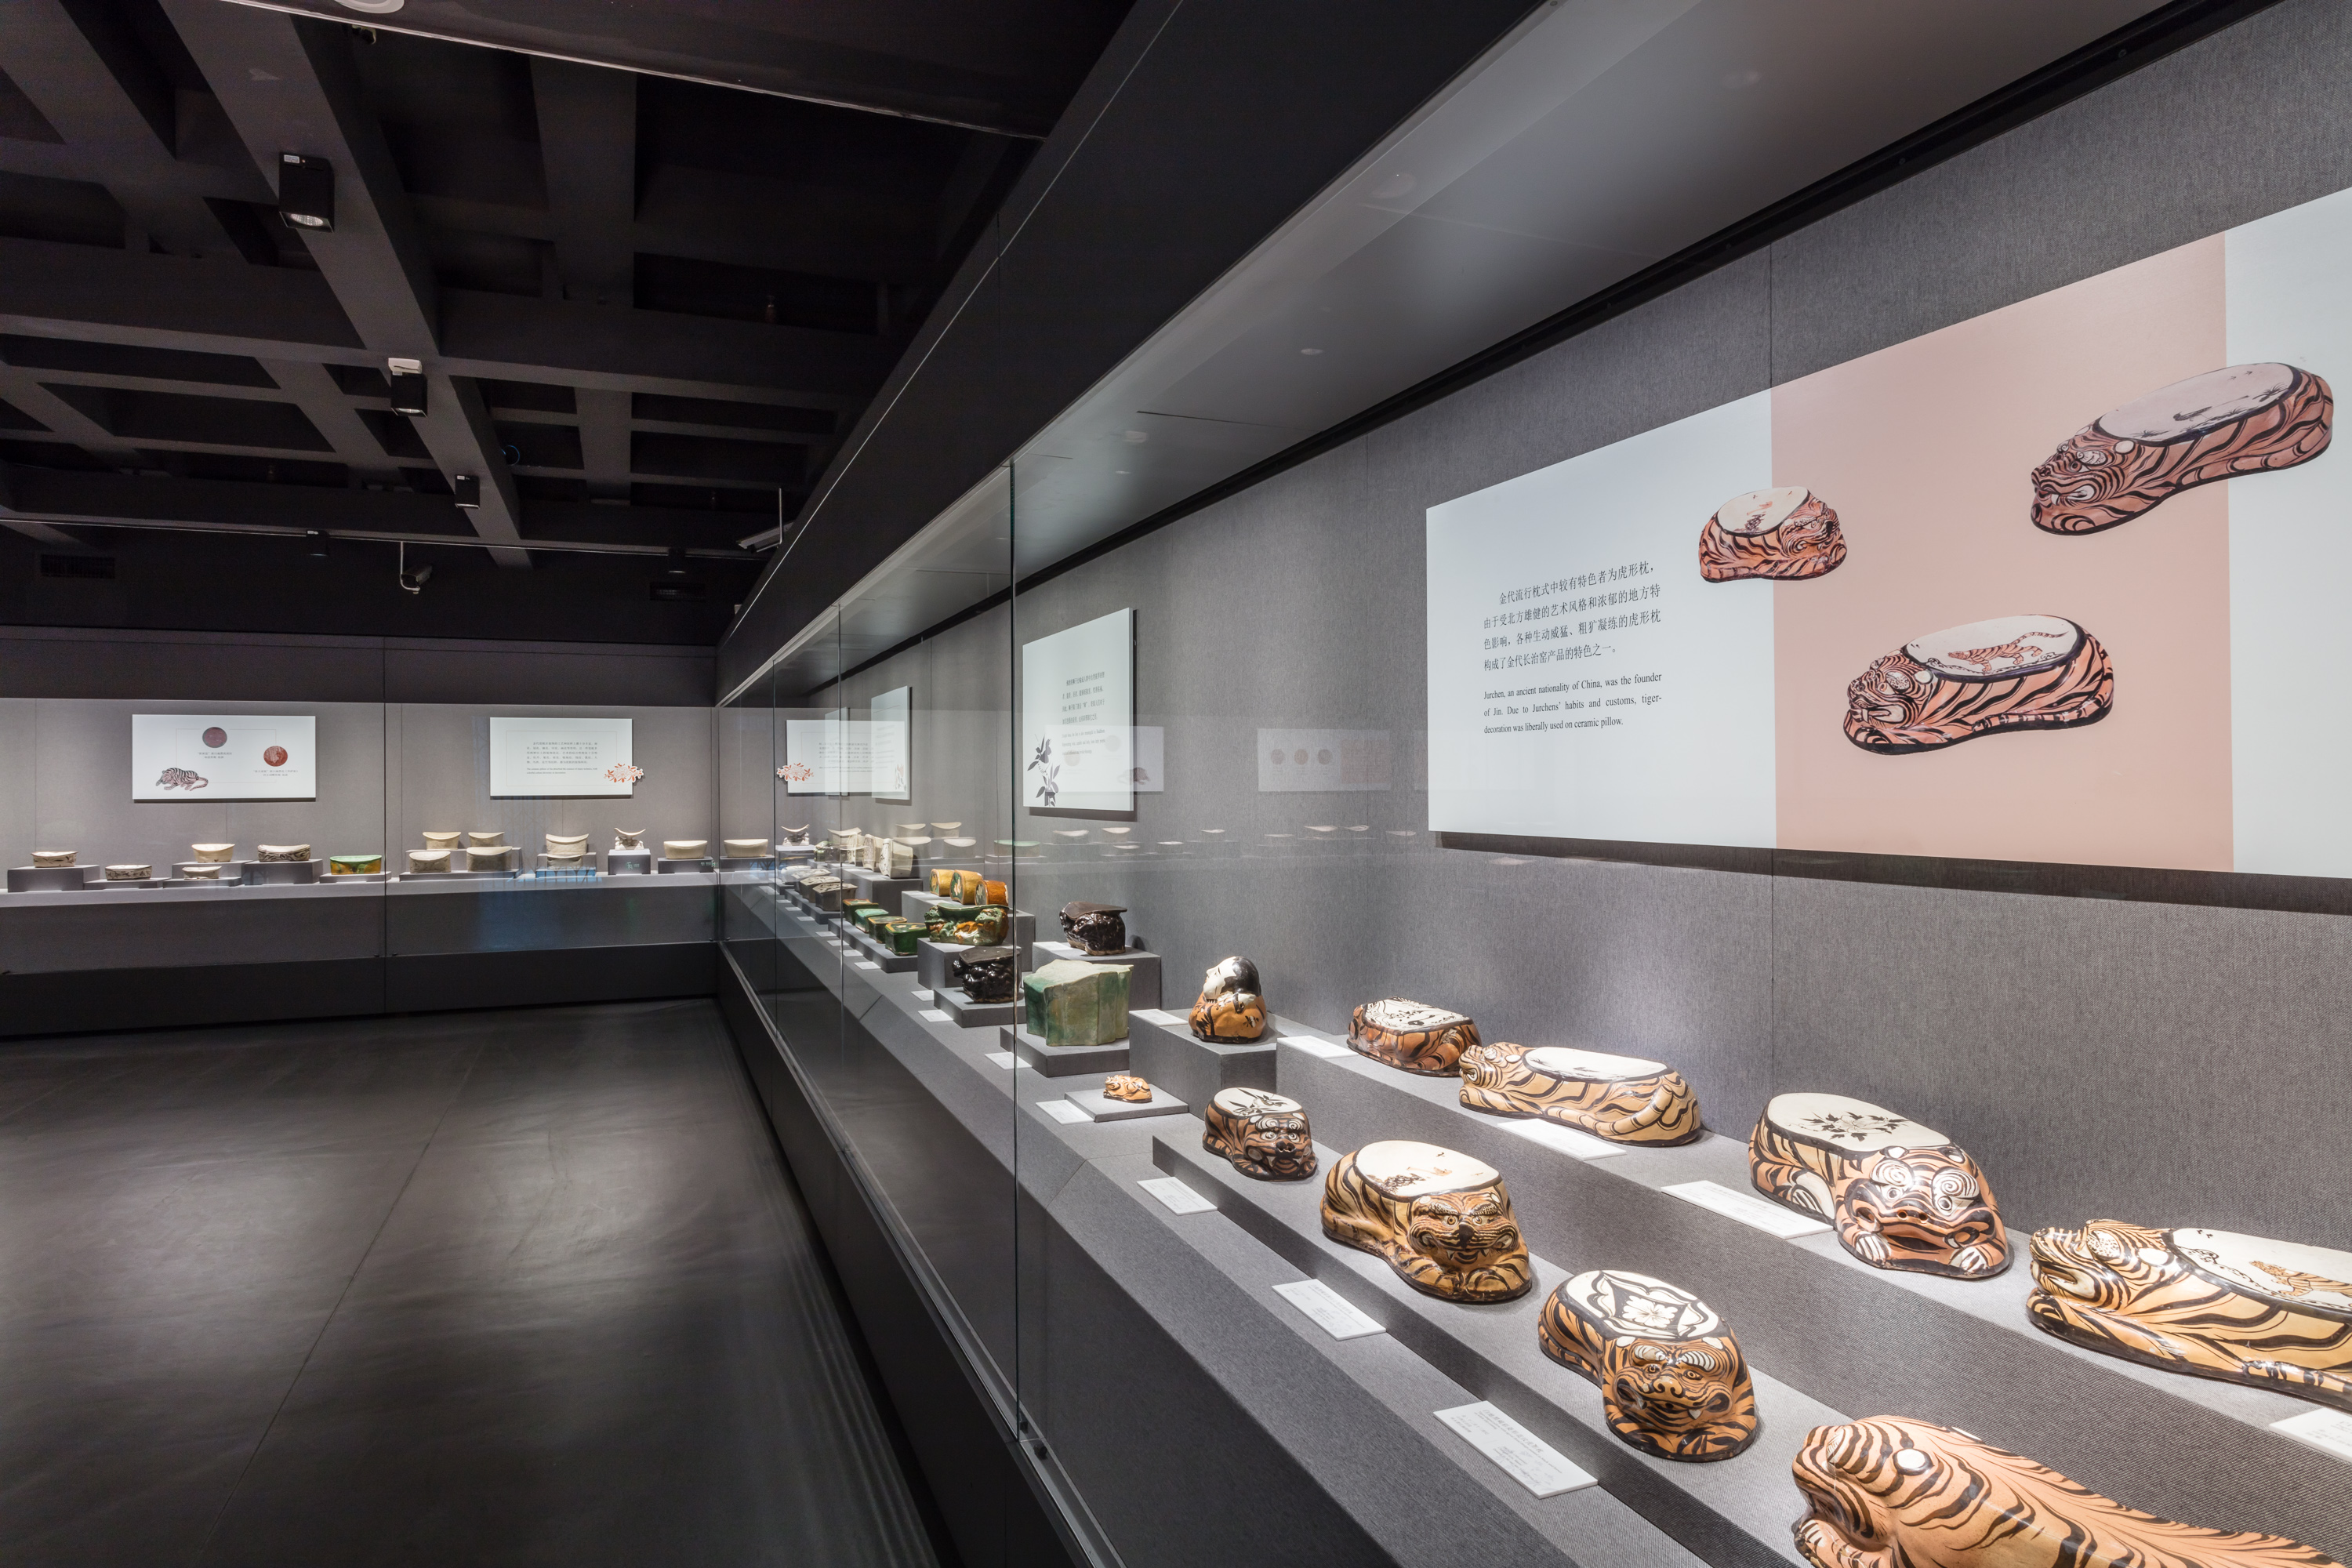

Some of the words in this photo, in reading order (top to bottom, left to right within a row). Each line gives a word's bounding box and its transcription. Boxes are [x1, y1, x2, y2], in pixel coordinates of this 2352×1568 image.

[1499, 561, 1653, 605] 金代流行枕式中较有特色者为虎形枕，
[1484, 583, 1661, 630] 由于受北方雄健的艺术风格和浓郁的地方特
[1484, 608, 1661, 651] 色影响，各种生动威猛、粗犷凝练的虎形枕
[1484, 644, 1616, 672] 构成了金代长治窑产品的特色之一。
[1484, 691, 1505, 699] Jurchen,
[1516, 687, 1536, 695] ancient
[1539, 683, 1570, 693] nationality
[1572, 681, 1580, 690] of
[1581, 680, 1602, 689] China,
[1621, 676, 1631, 684] the
[1635, 673, 1662, 683] founder
[1565, 700, 1584, 710] habits
[1589, 698, 1600, 707] and
[1642, 694, 1661, 705] tiger-
[1484, 724, 1512, 733] decoration
[1526, 721, 1548, 731] liberally
[1550, 720, 1563, 729] used
[1574, 718, 1599, 728] ceramic
[1601, 717, 1623, 728] pillow.
